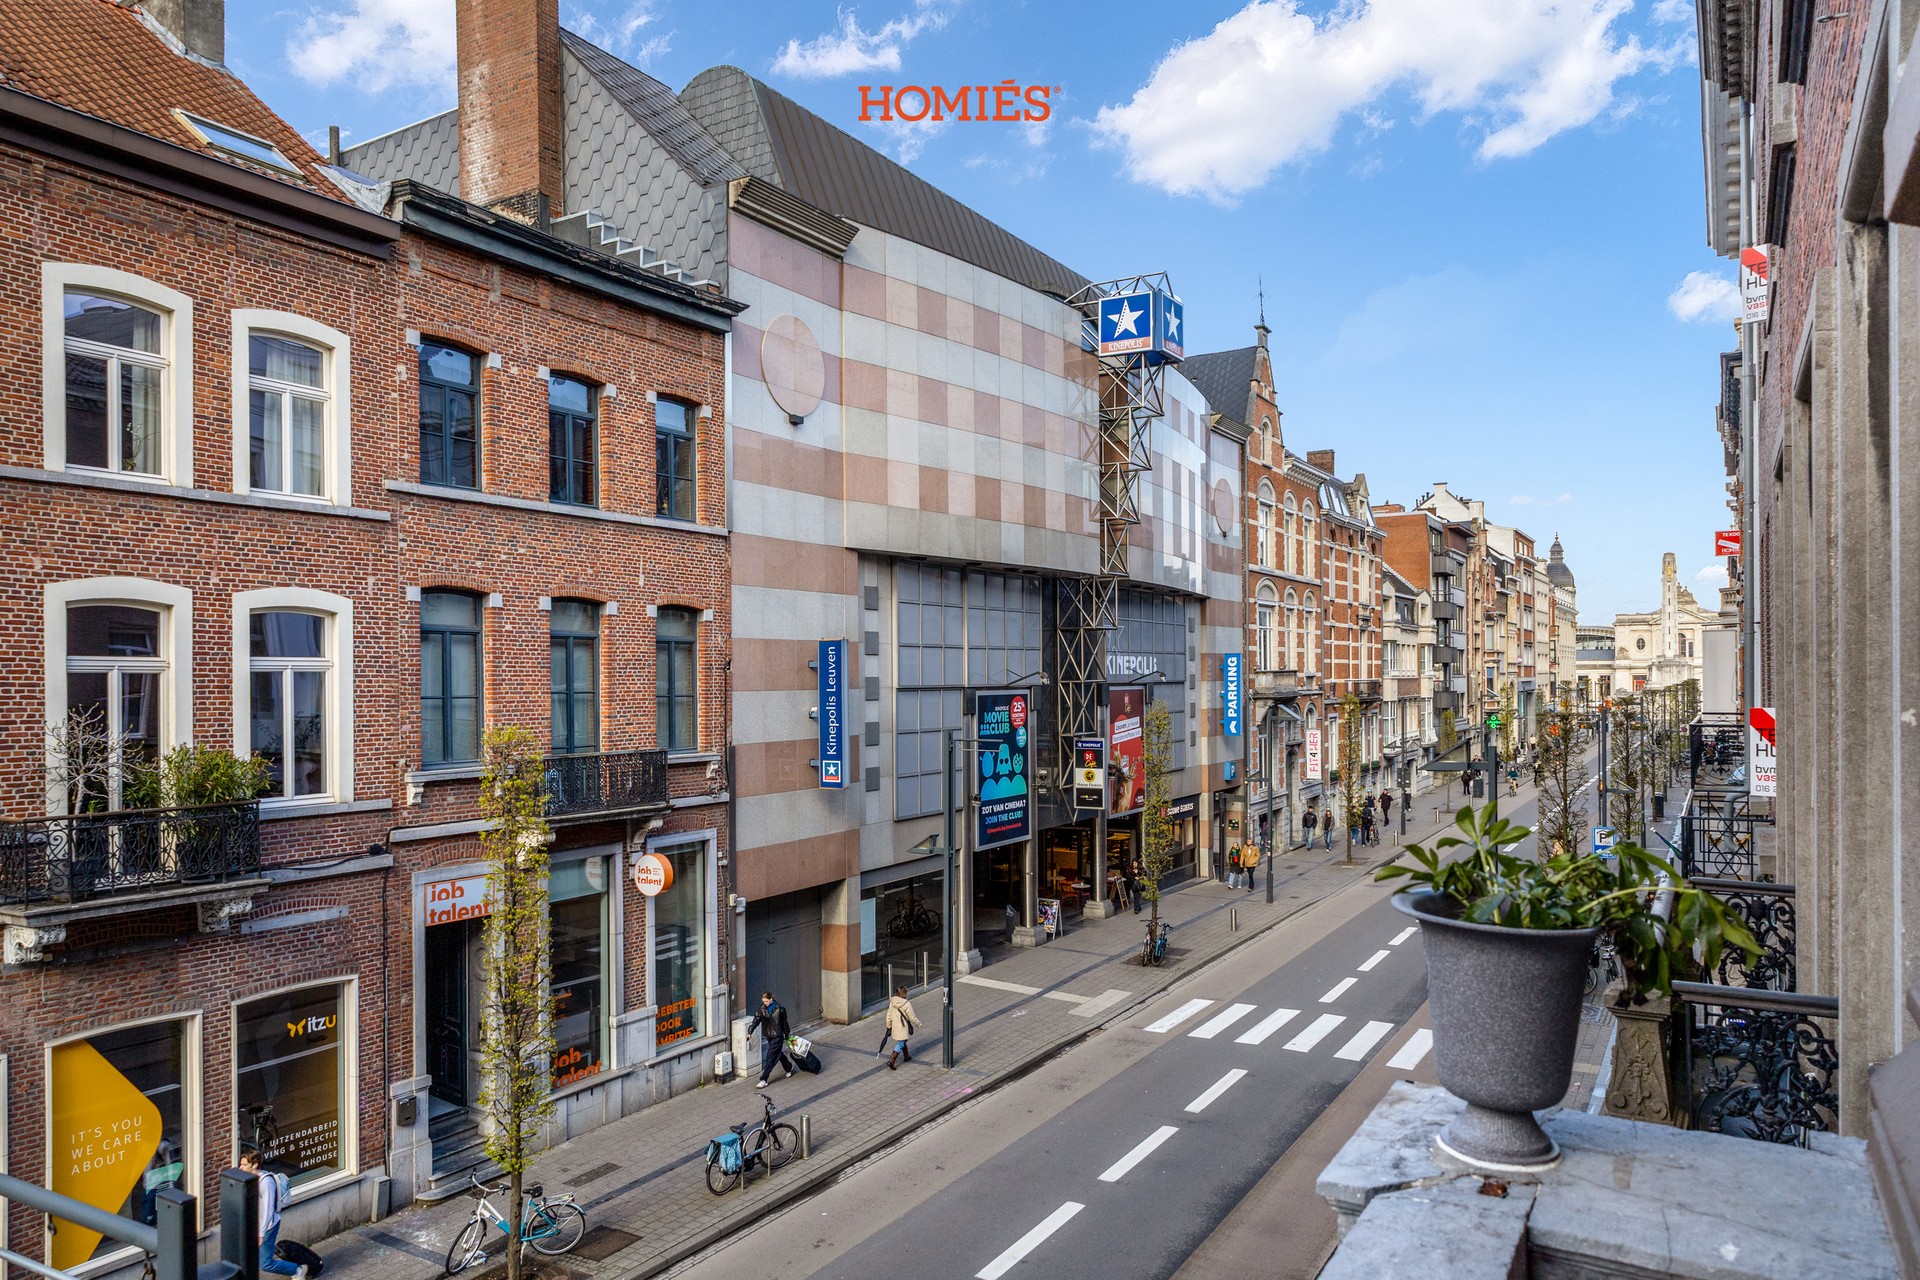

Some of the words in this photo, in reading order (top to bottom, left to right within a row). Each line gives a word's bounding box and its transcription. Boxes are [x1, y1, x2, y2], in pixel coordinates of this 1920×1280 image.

[1108, 340, 1143, 352] KINEPOLIS
[826, 646, 836, 692] Leuven
[1106, 655, 1157, 675] KINEPOLIS
[1228, 657, 1237, 717] PARKING
[826, 695, 839, 755] Kinepolis
[984, 711, 1009, 723] MOVIE
[990, 722, 1009, 735] CLUB
[981, 805, 993, 814] ZOT
[992, 803, 1004, 813] VAN
[1004, 799, 1027, 810] CINEMA?
[985, 815, 998, 825] JOIN
[998, 813, 1009, 822] THE
[1600, 833, 1607, 843] P
[638, 866, 651, 874] job
[637, 877, 662, 886] talent
[430, 881, 465, 903] job
[429, 902, 490, 924] talent
[307, 1014, 336, 1033] itzu
[71, 1126, 102, 1145] IT'S
[111, 1115, 142, 1133] YOU
[269, 1120, 338, 1148] UITZENDARBEID
[71, 1144, 93, 1159] WE
[103, 1130, 141, 1151] CARE
[289, 1144, 296, 1152] &
[299, 1130, 338, 1148] SELECTIE
[300, 1140, 338, 1158] PAYROLL
[71, 1150, 125, 1176] ABOUT
[300, 1150, 338, 1169] INHOUSE
